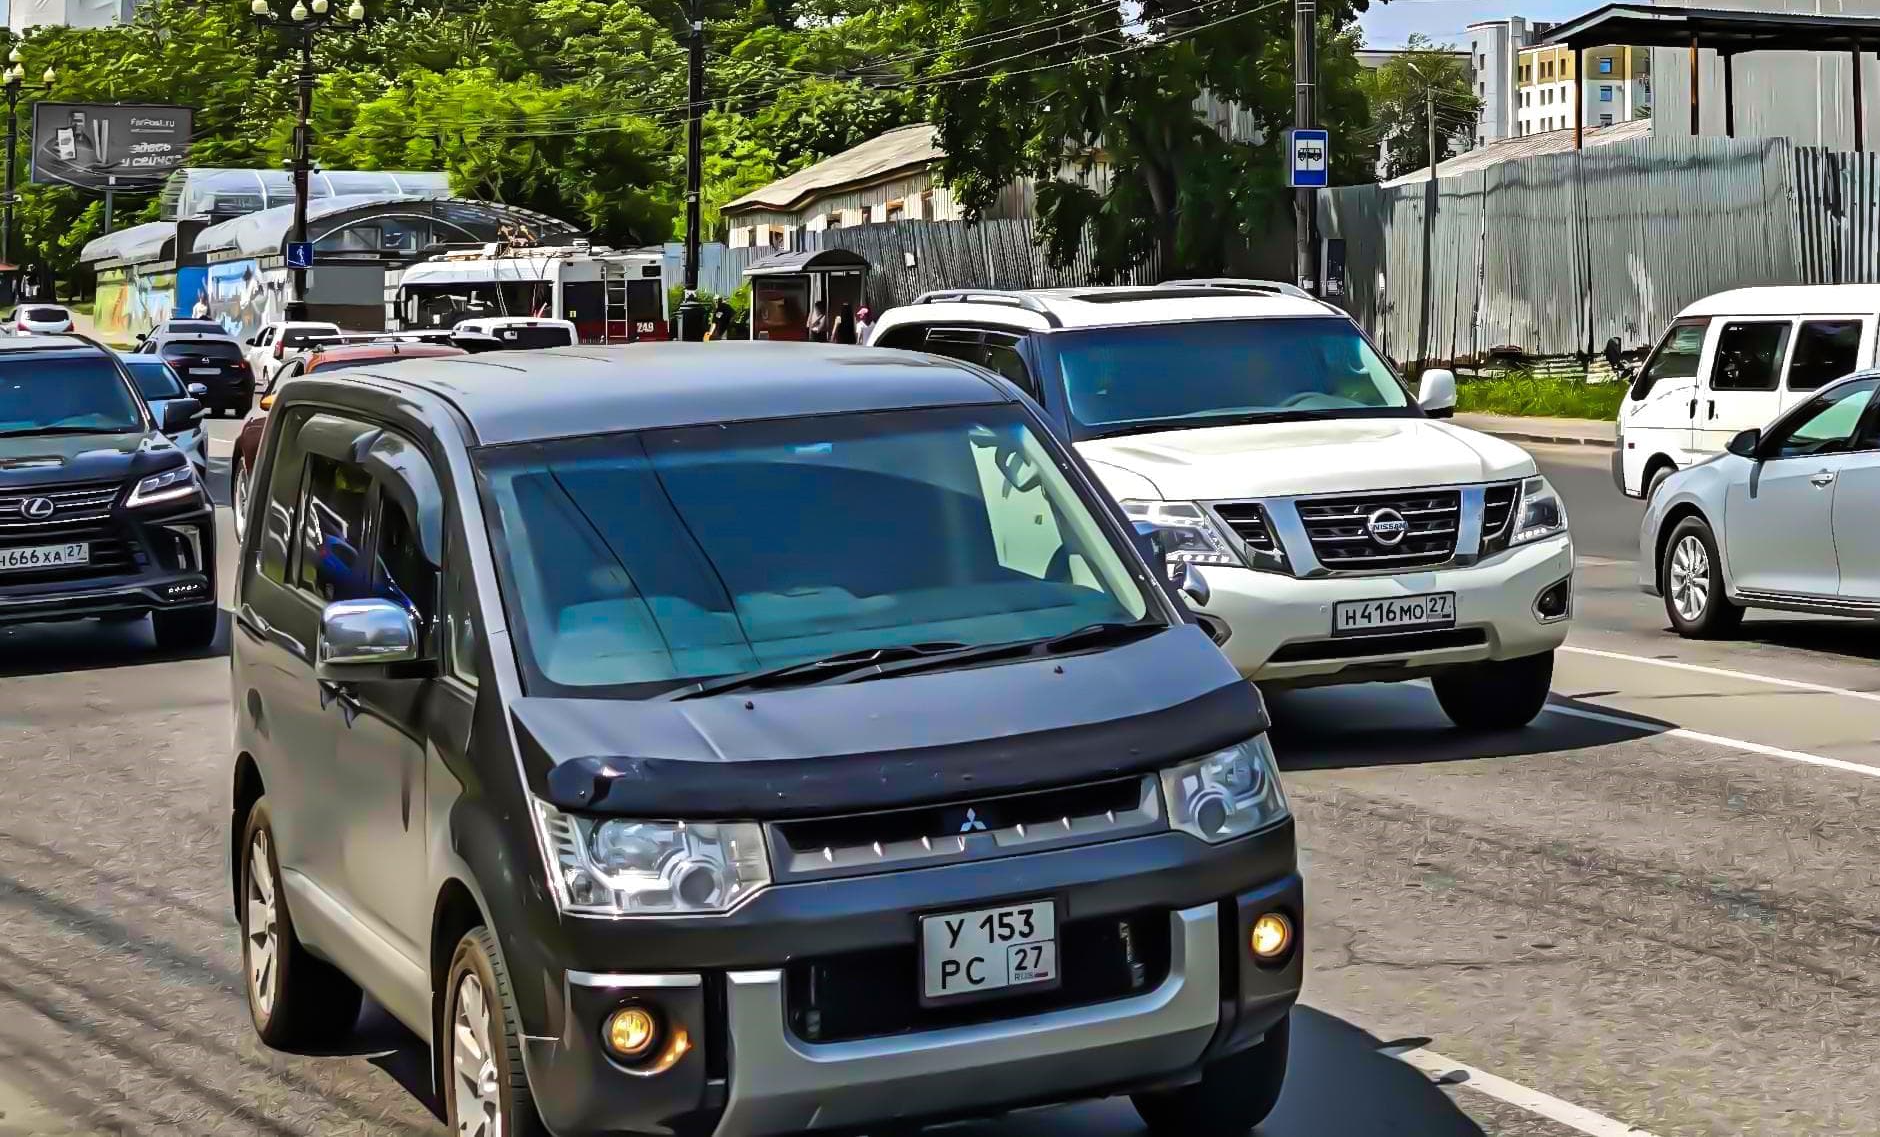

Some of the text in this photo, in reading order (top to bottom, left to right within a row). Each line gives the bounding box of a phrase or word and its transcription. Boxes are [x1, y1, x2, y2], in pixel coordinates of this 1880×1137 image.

[67, 544, 83, 557] 27
[1428, 596, 1447, 613] 27
[944, 908, 1035, 949] У 153
[1014, 945, 1043, 971] 27
[941, 956, 986, 990] РС
